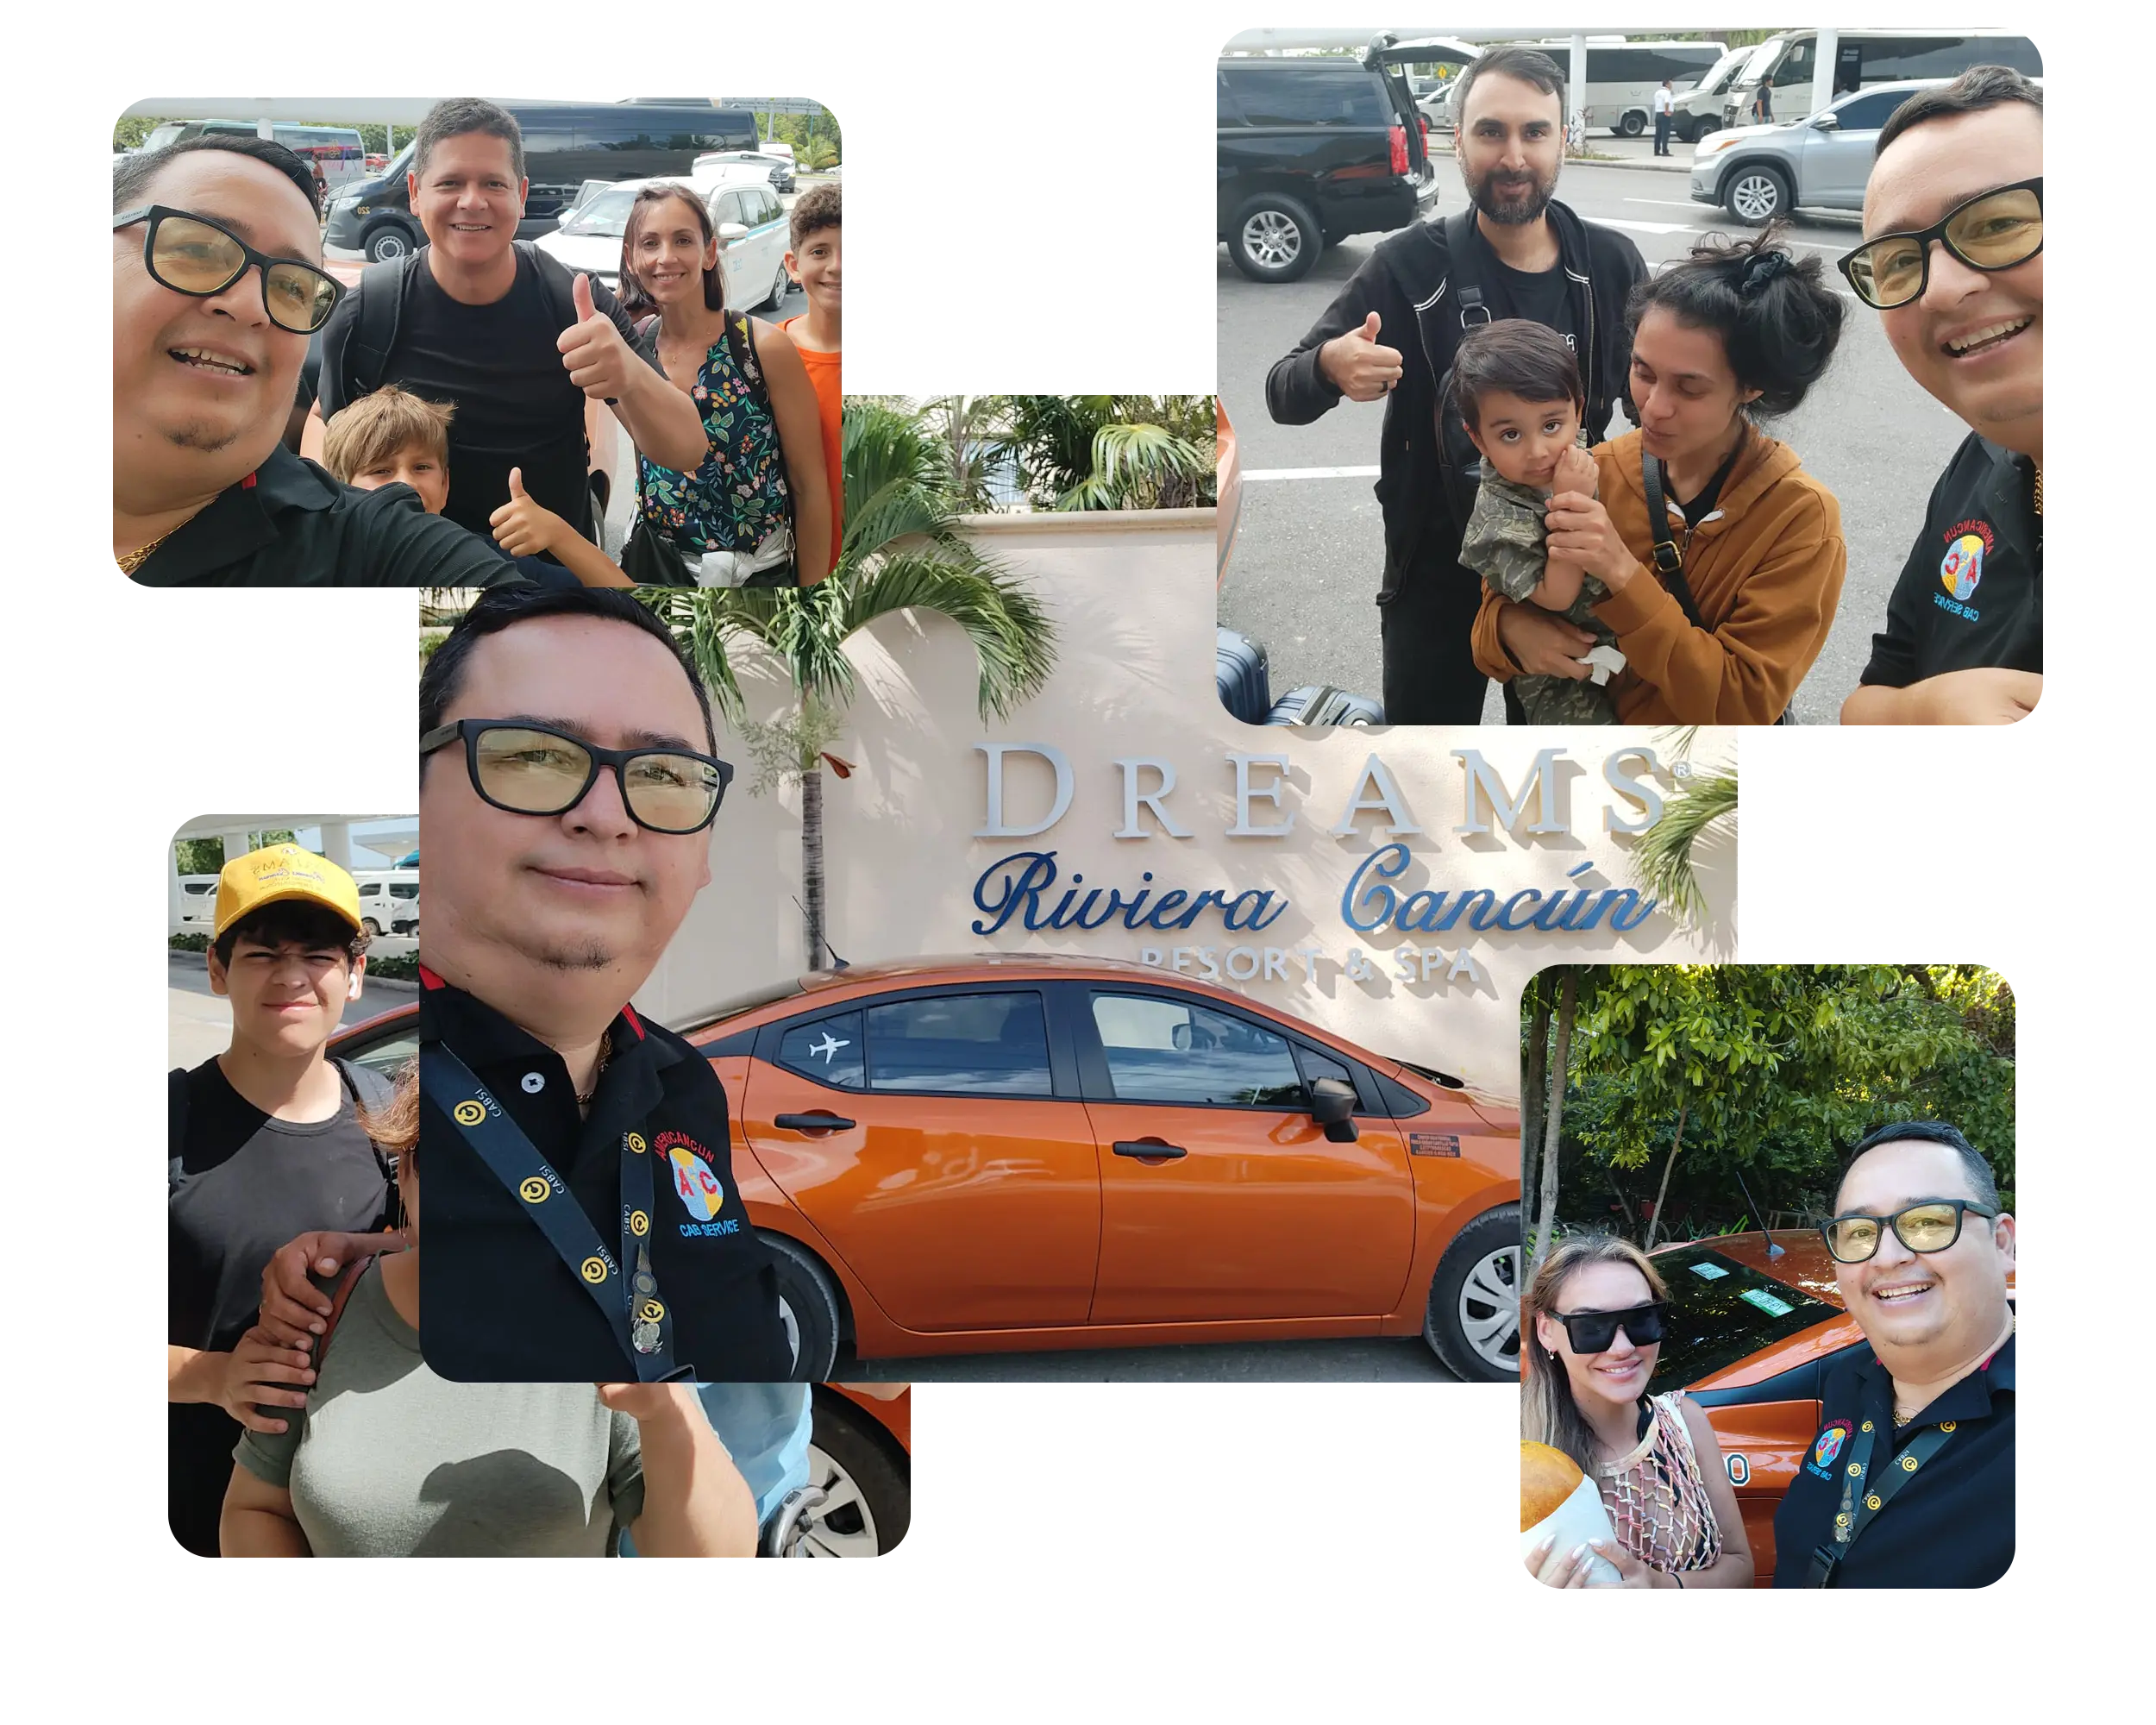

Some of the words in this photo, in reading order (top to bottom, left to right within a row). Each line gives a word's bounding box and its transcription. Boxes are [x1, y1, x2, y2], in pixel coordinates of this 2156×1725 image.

[971, 850, 1289, 936] Riviera
[1340, 842, 1658, 933] Cancún
[1344, 947, 1375, 982] &
[1393, 946, 1481, 982] SPA
[474, 1088, 502, 1118] CABSI
[653, 1131, 715, 1162] AMERICANCUN
[538, 1164, 565, 1195] CABSI
[680, 1224, 703, 1238] CAB
[701, 1219, 740, 1237] SERVICE
[596, 1245, 619, 1275] CABSI
